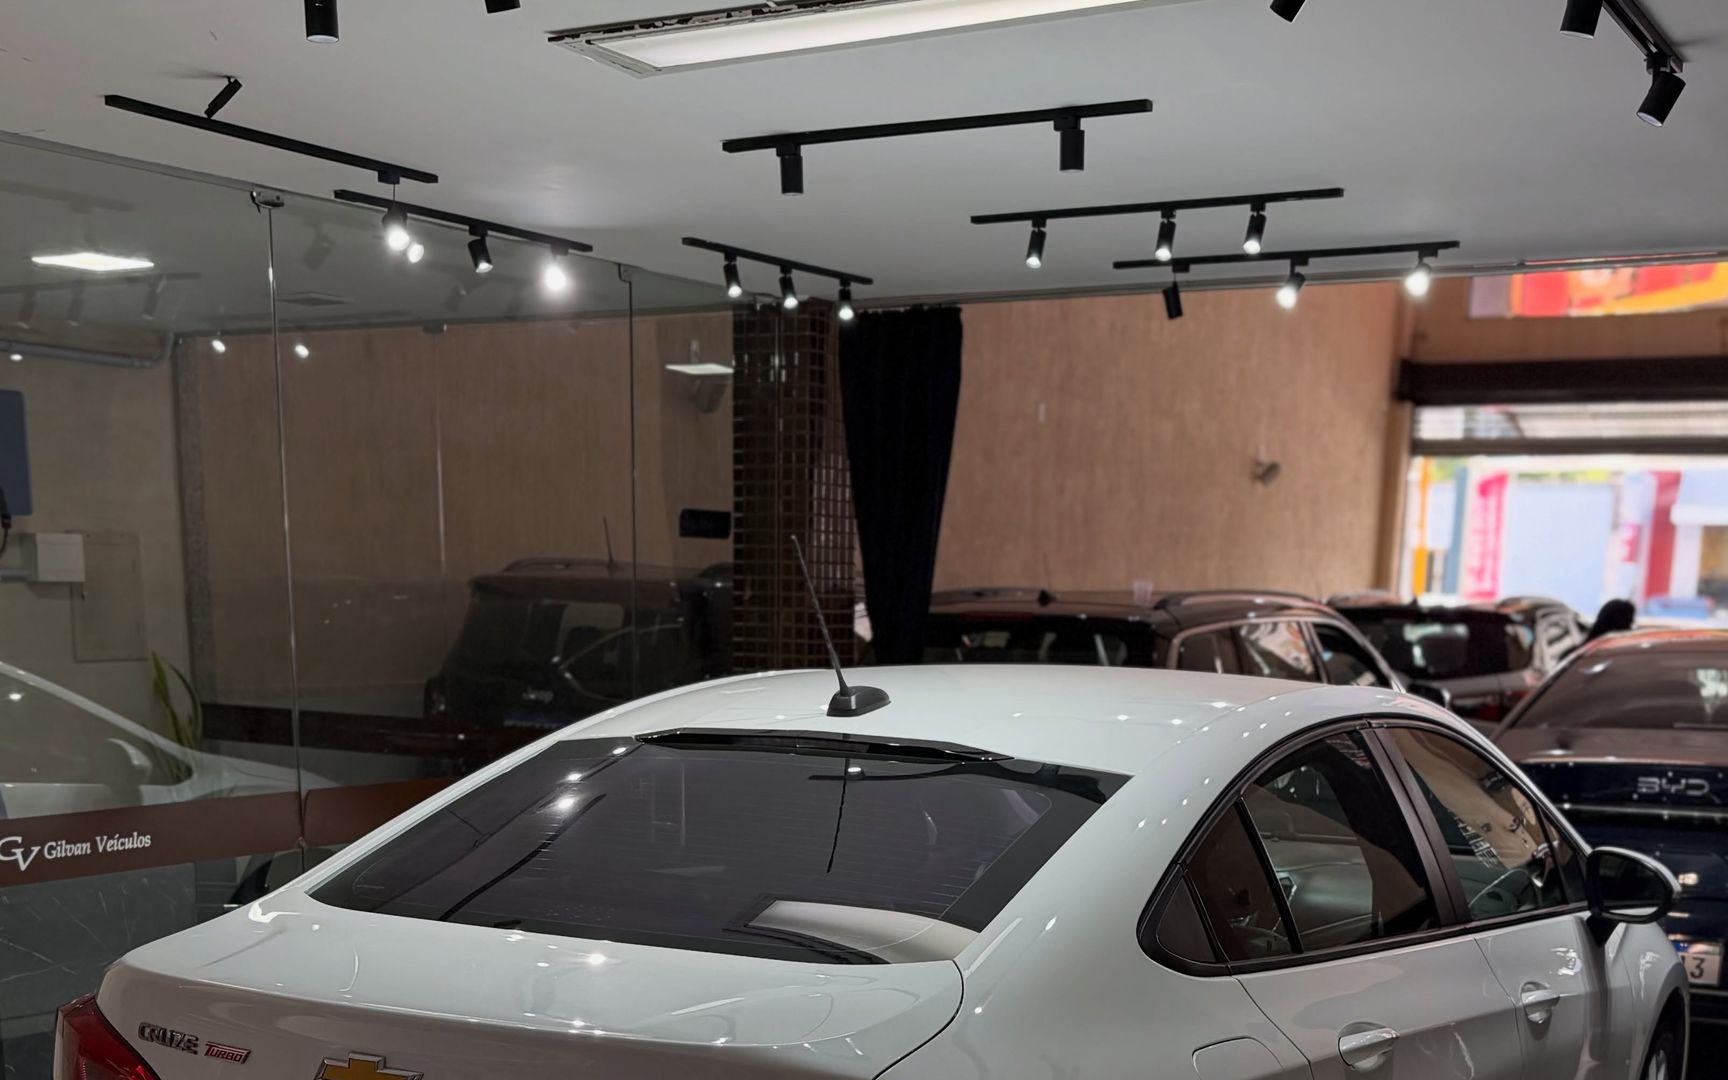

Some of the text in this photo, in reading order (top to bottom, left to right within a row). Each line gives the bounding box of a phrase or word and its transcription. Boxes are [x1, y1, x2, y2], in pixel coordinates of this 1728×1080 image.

[1637, 776, 1709, 796] BYD
[43, 840, 91, 859] Gilvan
[96, 832, 151, 853] Veículos
[138, 1021, 199, 1055] CRUZE
